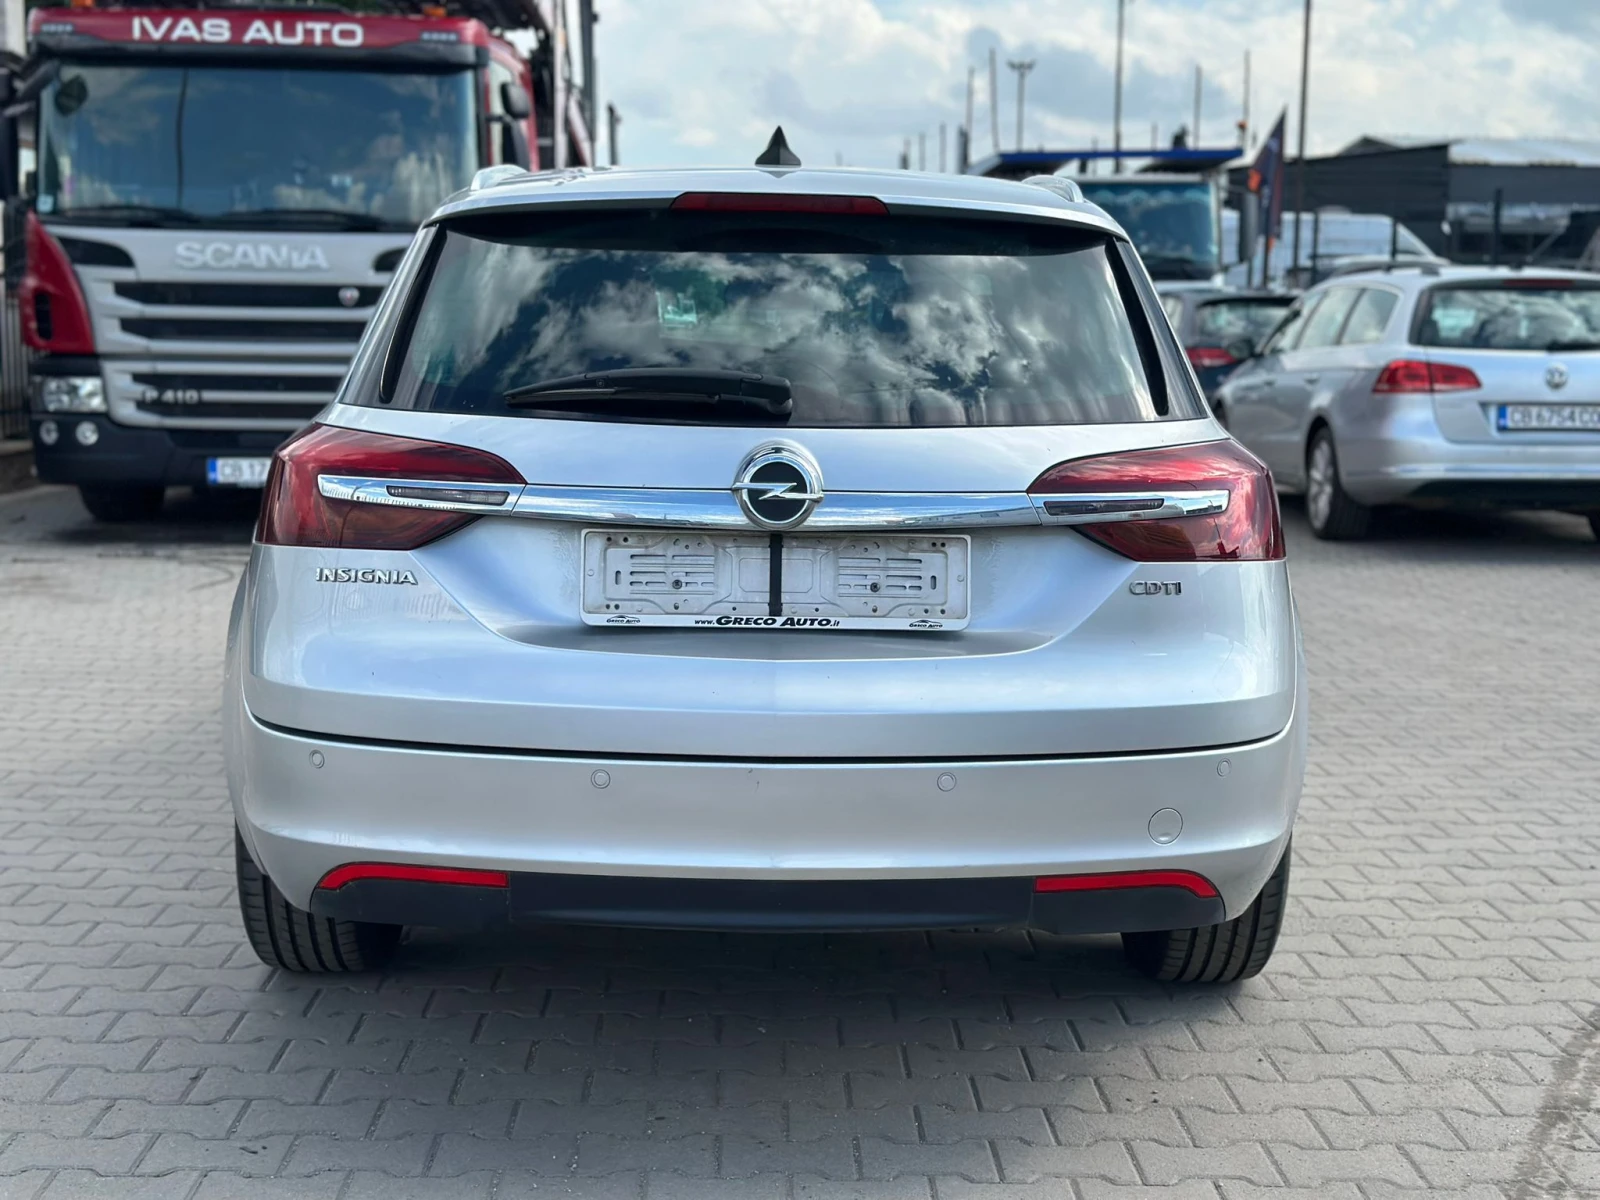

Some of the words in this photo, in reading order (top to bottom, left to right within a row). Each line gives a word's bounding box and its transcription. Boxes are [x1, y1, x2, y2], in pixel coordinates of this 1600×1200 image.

[132, 16, 232, 43] IVAS
[242, 19, 364, 47] AUTO
[175, 241, 329, 271] SCANIA
[144, 388, 159, 404] P
[161, 388, 199, 404] 410
[315, 567, 419, 586] INSIGNIA
[1128, 579, 1183, 596] CDTI
